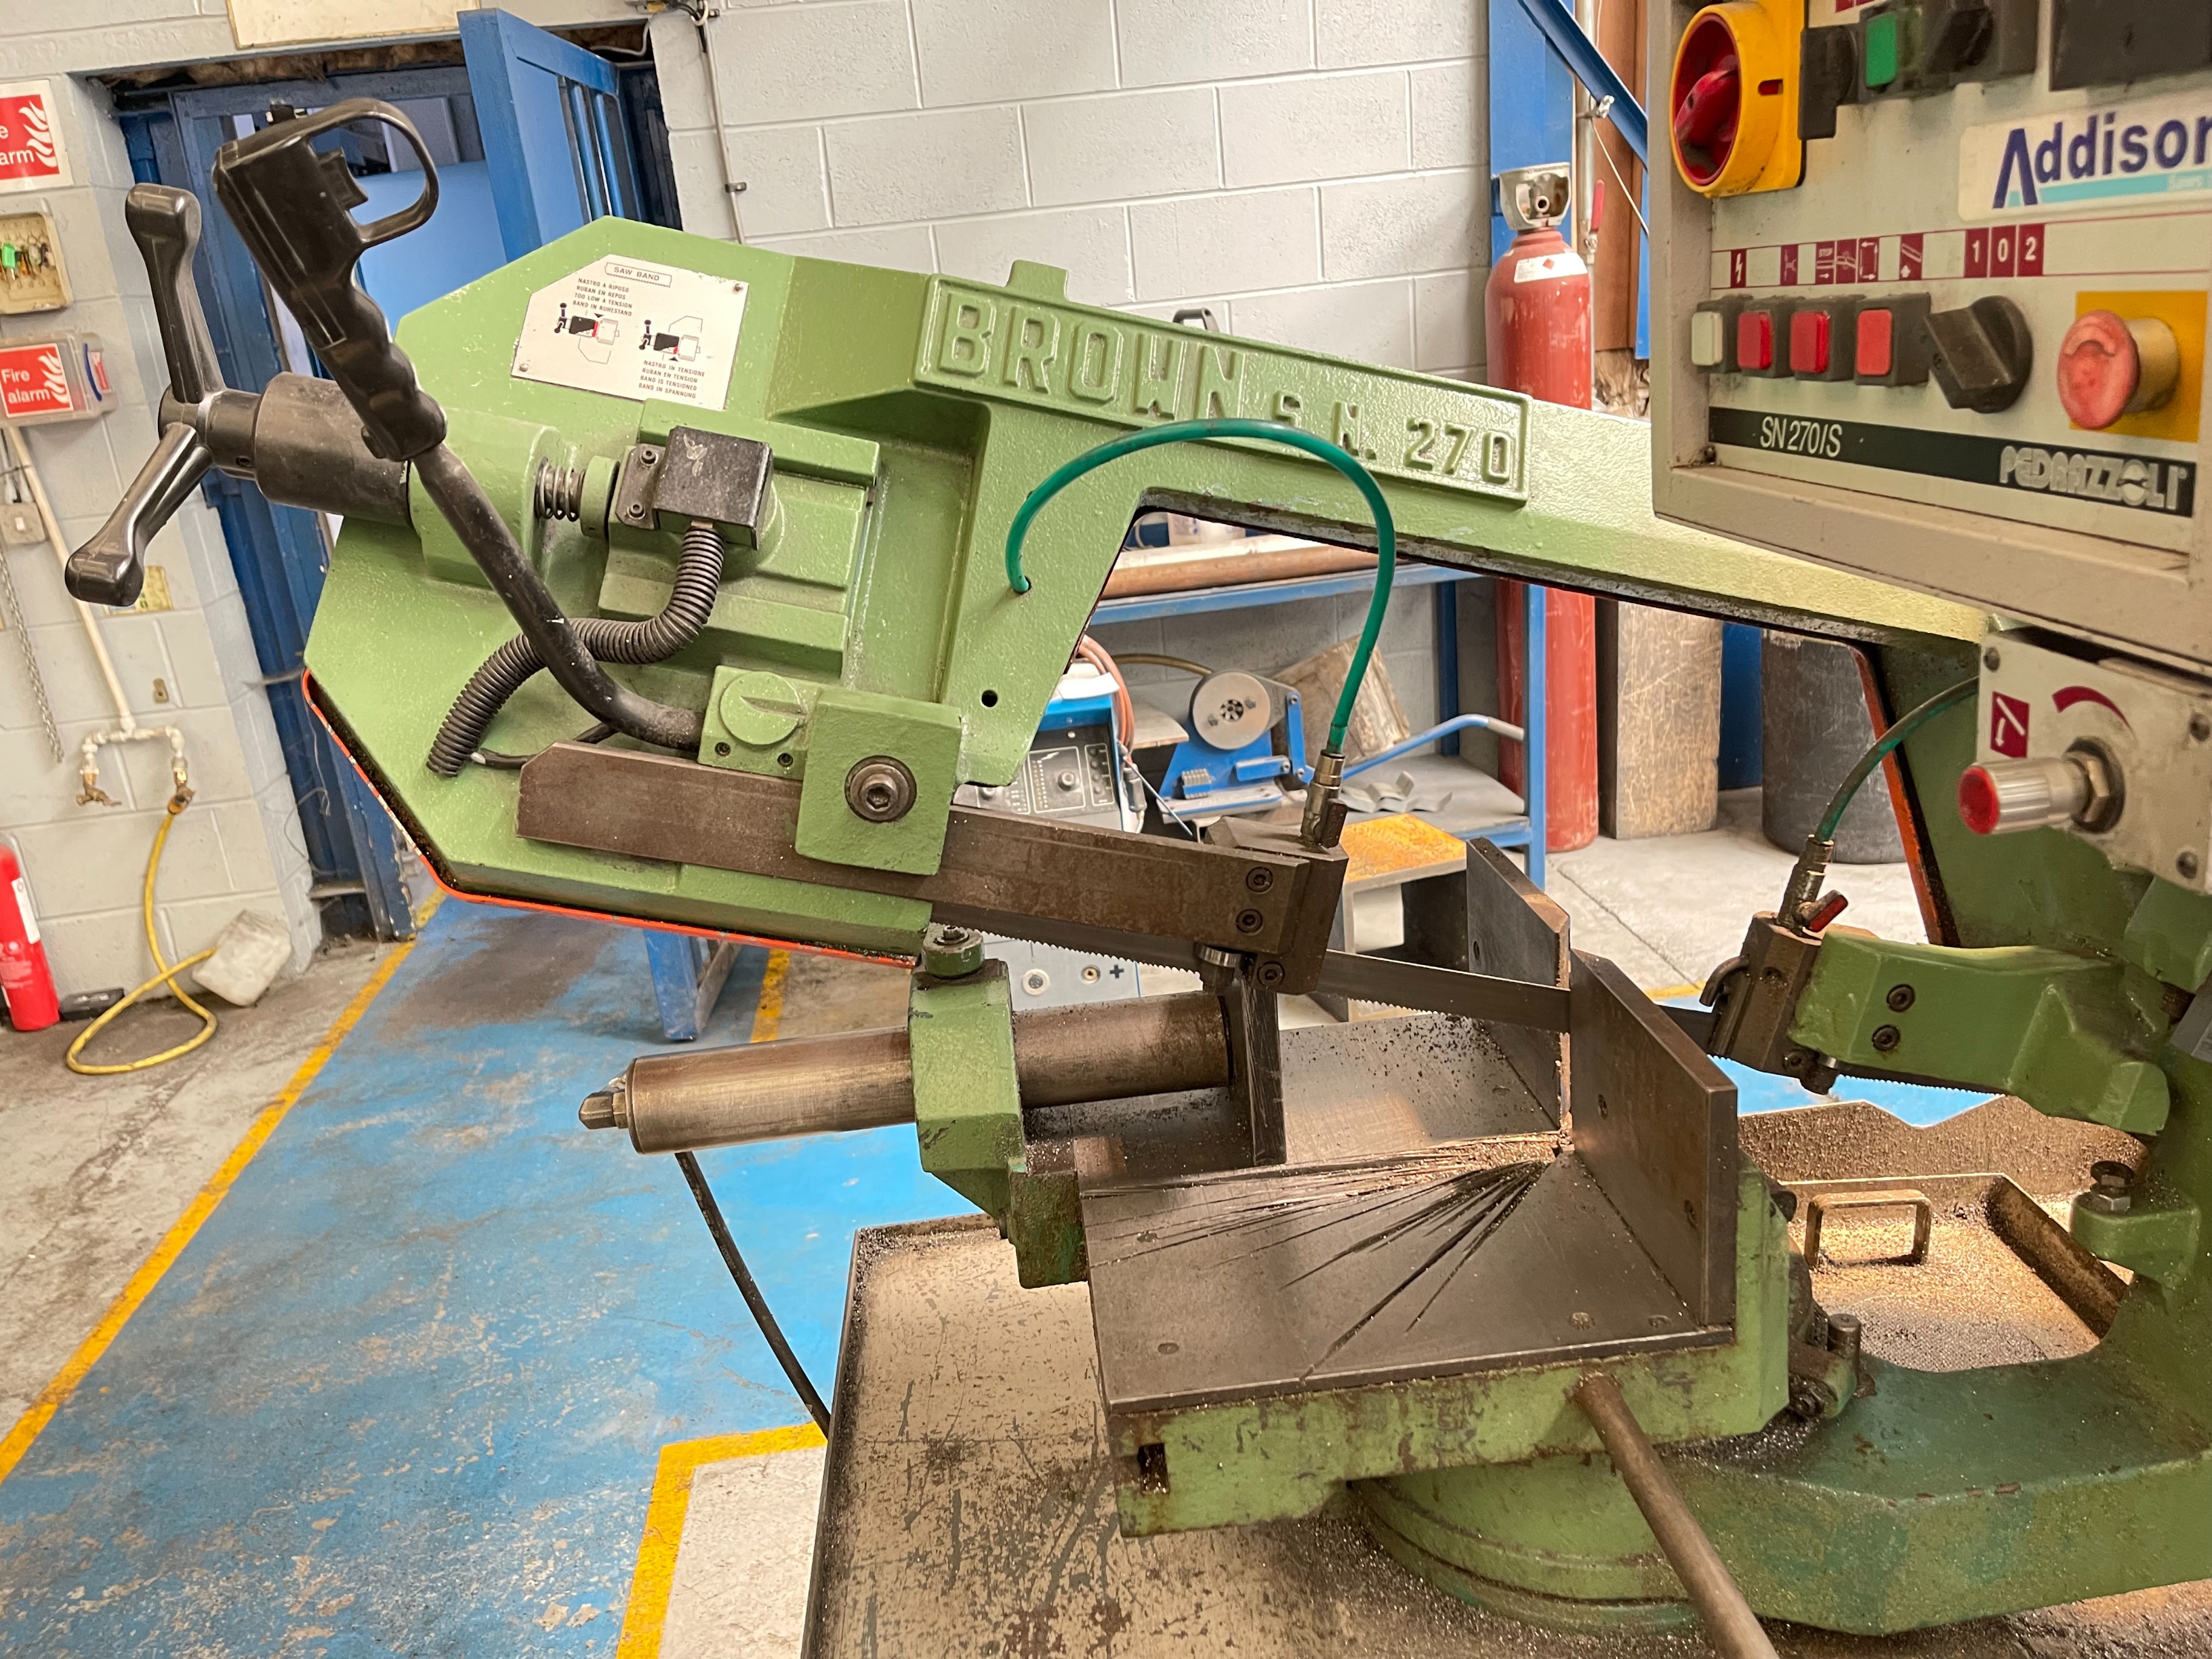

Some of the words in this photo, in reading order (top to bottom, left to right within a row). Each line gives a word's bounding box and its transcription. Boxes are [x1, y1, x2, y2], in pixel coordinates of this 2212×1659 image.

[0, 149, 35, 165] arm
[1972, 240, 1980, 263] 1
[2024, 237, 2036, 261] 2
[614, 266, 632, 275] SAW
[636, 271, 659, 281] BAND
[576, 285, 596, 293] RUBAN
[608, 291, 626, 300] REPOS
[578, 278, 600, 287] NASTRO
[609, 284, 629, 293] RIPOSO
[573, 300, 588, 308] BAND
[609, 299, 632, 308] TENSION
[642, 367, 661, 376] RUBAN
[674, 373, 697, 383] TENSION
[644, 360, 666, 369] NASTRO
[678, 367, 705, 377] TENSIONE
[1, 369, 30, 384] Fire
[640, 375, 656, 383] BAND
[666, 380, 697, 391] TENSIONED
[665, 388, 696, 398] SPANNUNG
[937, 291, 1246, 420] BROWN
[1402, 416, 1512, 484] 270
[7, 388, 51, 405] alarm
